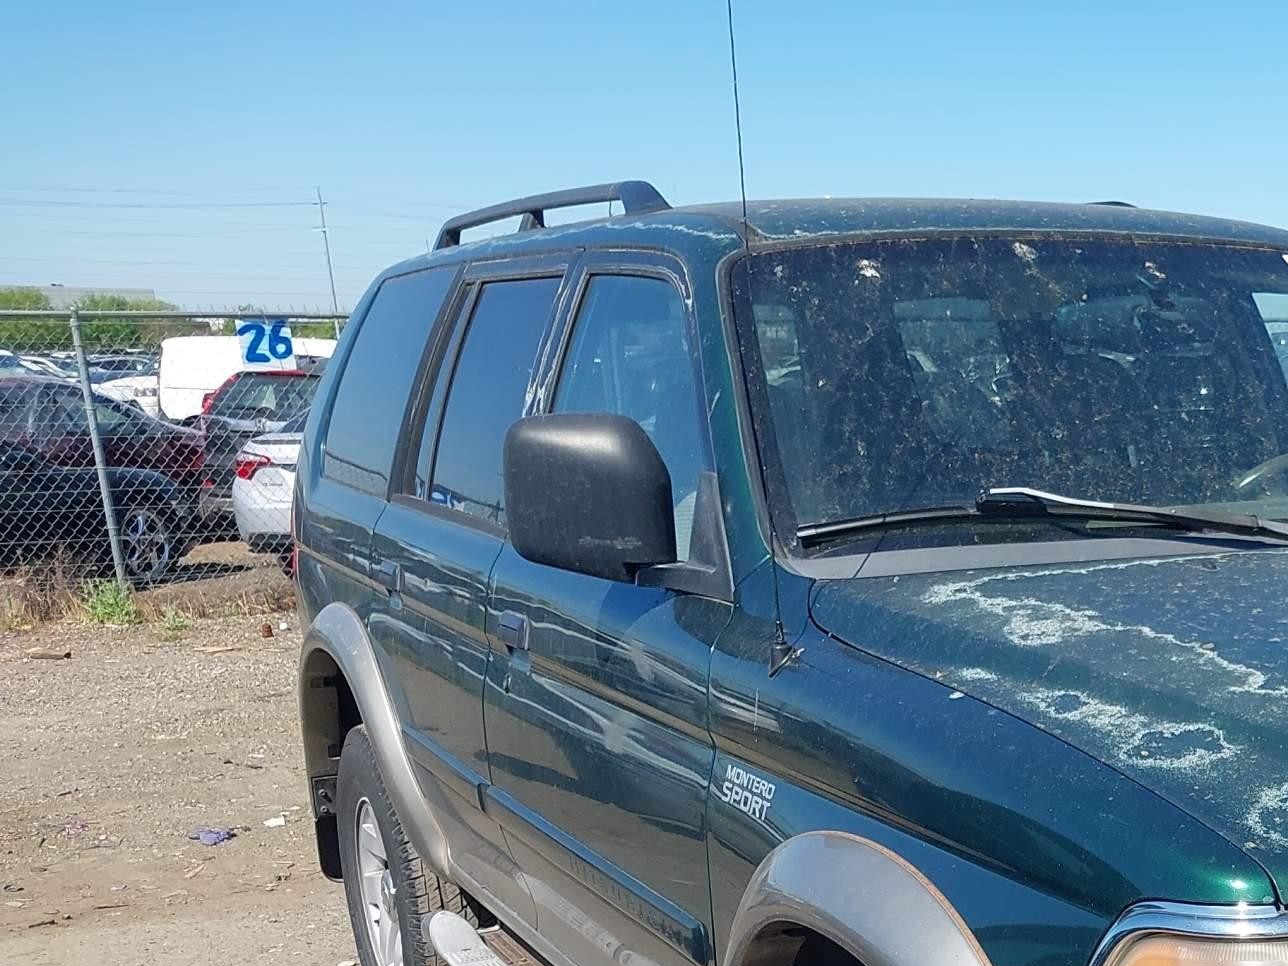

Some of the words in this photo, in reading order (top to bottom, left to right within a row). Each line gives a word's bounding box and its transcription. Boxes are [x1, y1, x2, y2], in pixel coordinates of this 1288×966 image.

[237, 320, 293, 363] 26
[721, 781, 771, 820] SPORT
[725, 764, 776, 800] MONTERO
